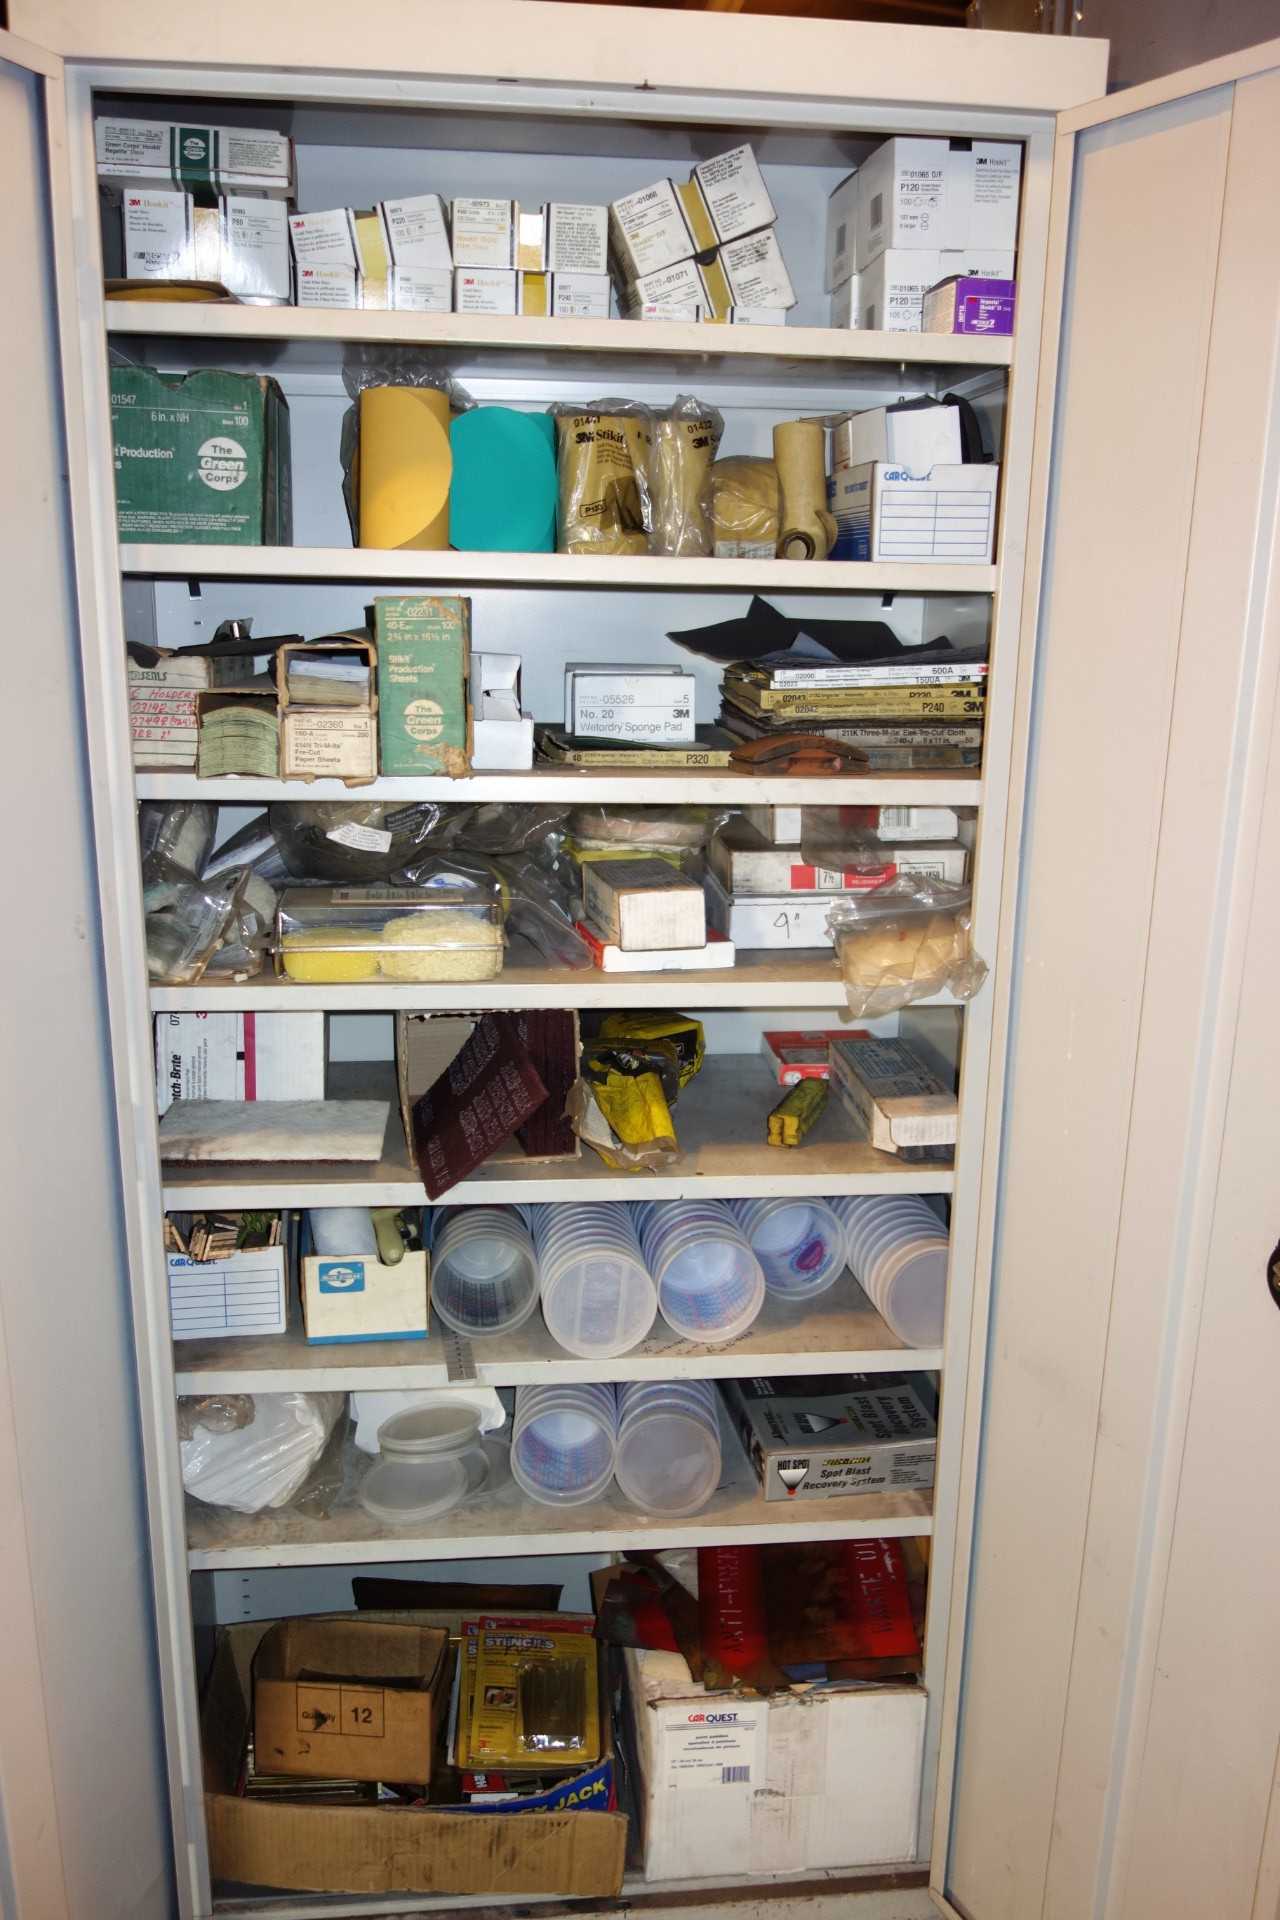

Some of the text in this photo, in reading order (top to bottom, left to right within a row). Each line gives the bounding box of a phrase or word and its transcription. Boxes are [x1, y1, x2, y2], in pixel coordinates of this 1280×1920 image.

[900, 183, 920, 192] P120
[128, 198, 141, 206] 3M
[293, 221, 305, 229] 3M
[302, 270, 314, 278] 3M
[463, 278, 475, 286] 3M
[889, 297, 909, 305] P120
[111, 394, 137, 404] 01547
[151, 412, 157, 421] 6
[234, 416, 249, 426] 100
[595, 430, 625, 444] Stikit
[692, 437, 709, 449] 3M
[120, 447, 173, 458] Production
[212, 444, 233, 455] The
[200, 457, 244, 471] Green
[204, 472, 239, 484] Corps
[602, 694, 635, 704] 05526
[683, 694, 689, 704] 5
[415, 705, 433, 713] The
[922, 703, 945, 713] P240
[963, 702, 984, 712] 3M
[580, 709, 690, 719] No. 20 3M
[406, 716, 442, 725] Green
[410, 727, 437, 735] Corps
[580, 721, 683, 733] Wetordry Sponge Pad
[947, 729, 967, 737] Cloth
[686, 754, 709, 764] P320
[777, 1459, 791, 1470] HOT
[820, 1466, 872, 1479] Spot Blast
[802, 1476, 886, 1491] Recovery System
[485, 1637, 555, 1650] STENCILS
[351, 1707, 373, 1724] 12
[554, 1777, 607, 1812] JACK
